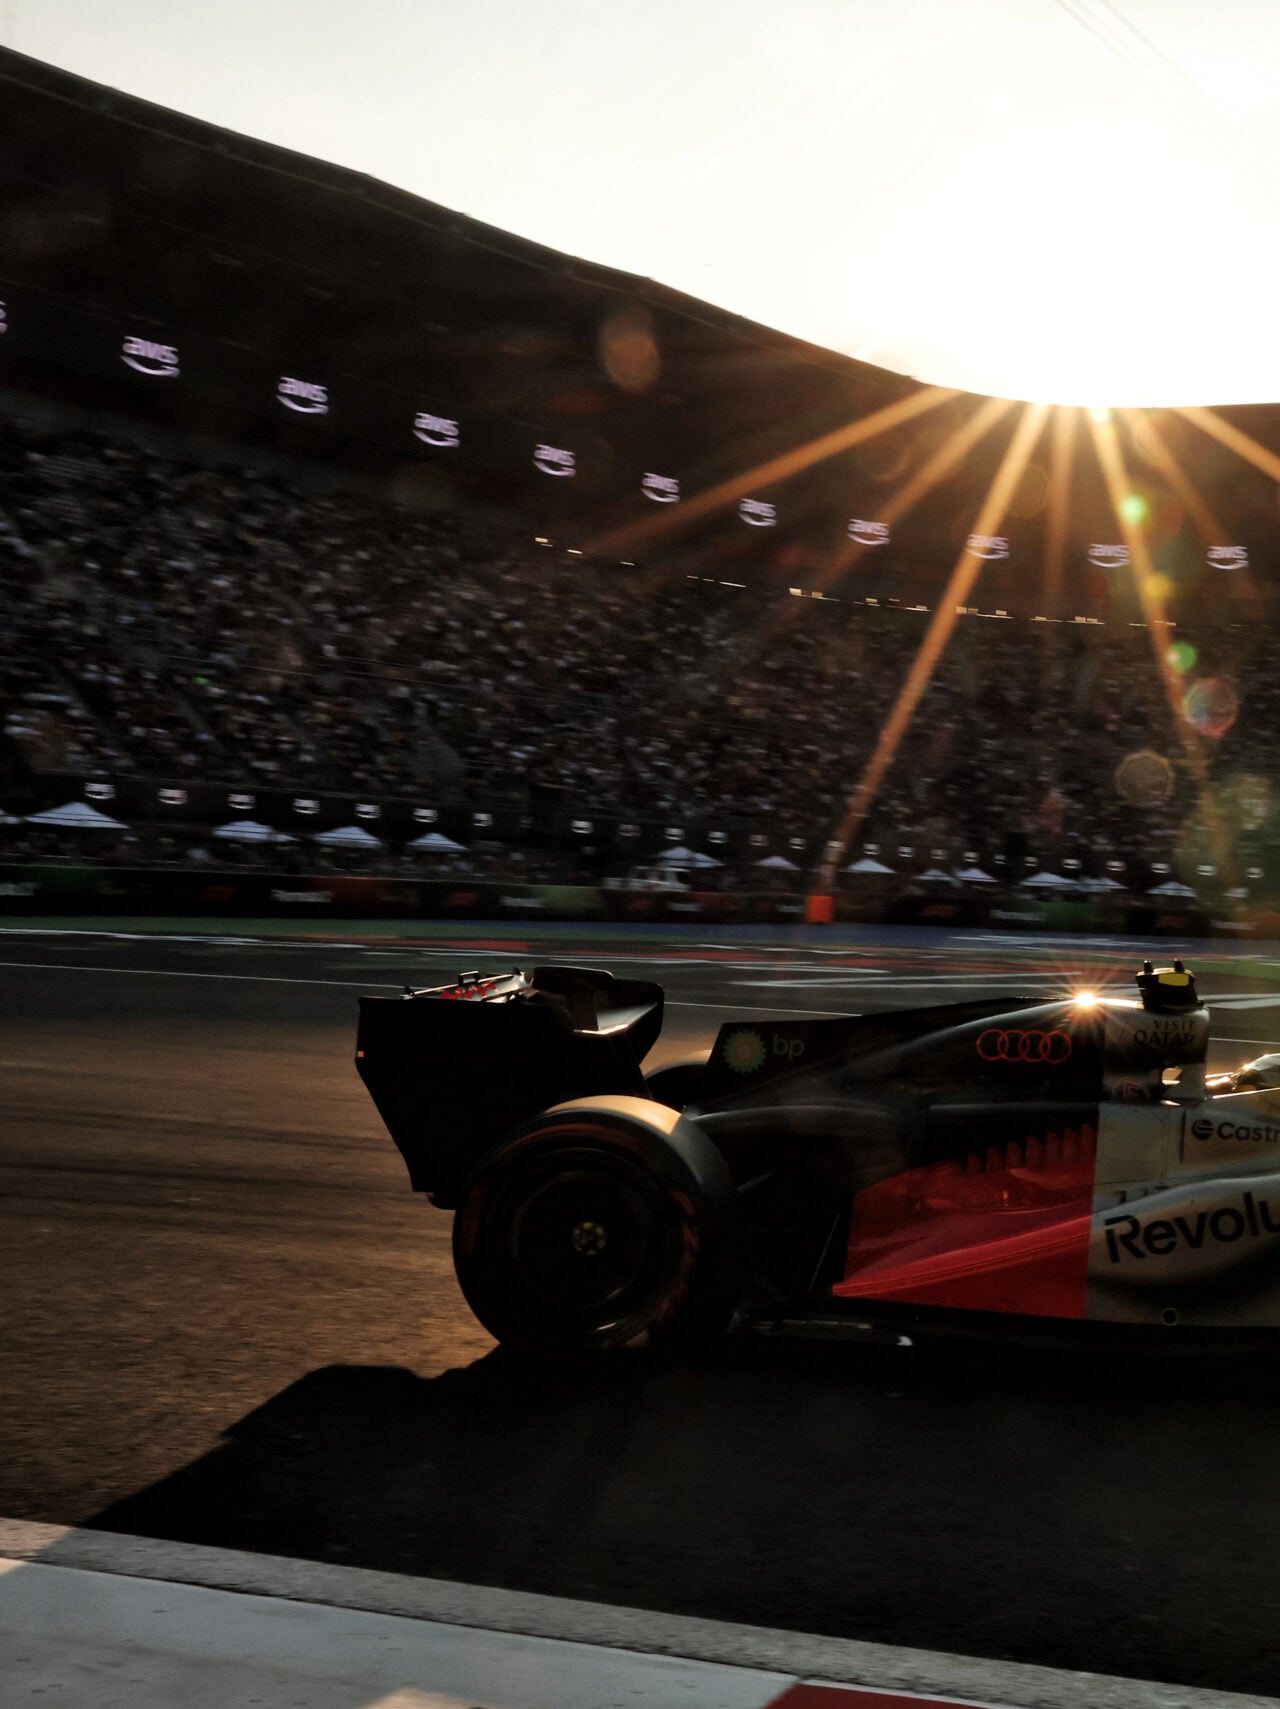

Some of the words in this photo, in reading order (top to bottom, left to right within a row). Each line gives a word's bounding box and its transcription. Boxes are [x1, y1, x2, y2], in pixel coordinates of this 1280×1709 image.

[122, 336, 179, 364] aws
[277, 376, 329, 402] aws
[413, 412, 460, 437] aws
[534, 443, 576, 467] aws
[642, 472, 680, 494] aws
[772, 1032, 805, 1061] bp
[1134, 1029, 1195, 1047] QATAR
